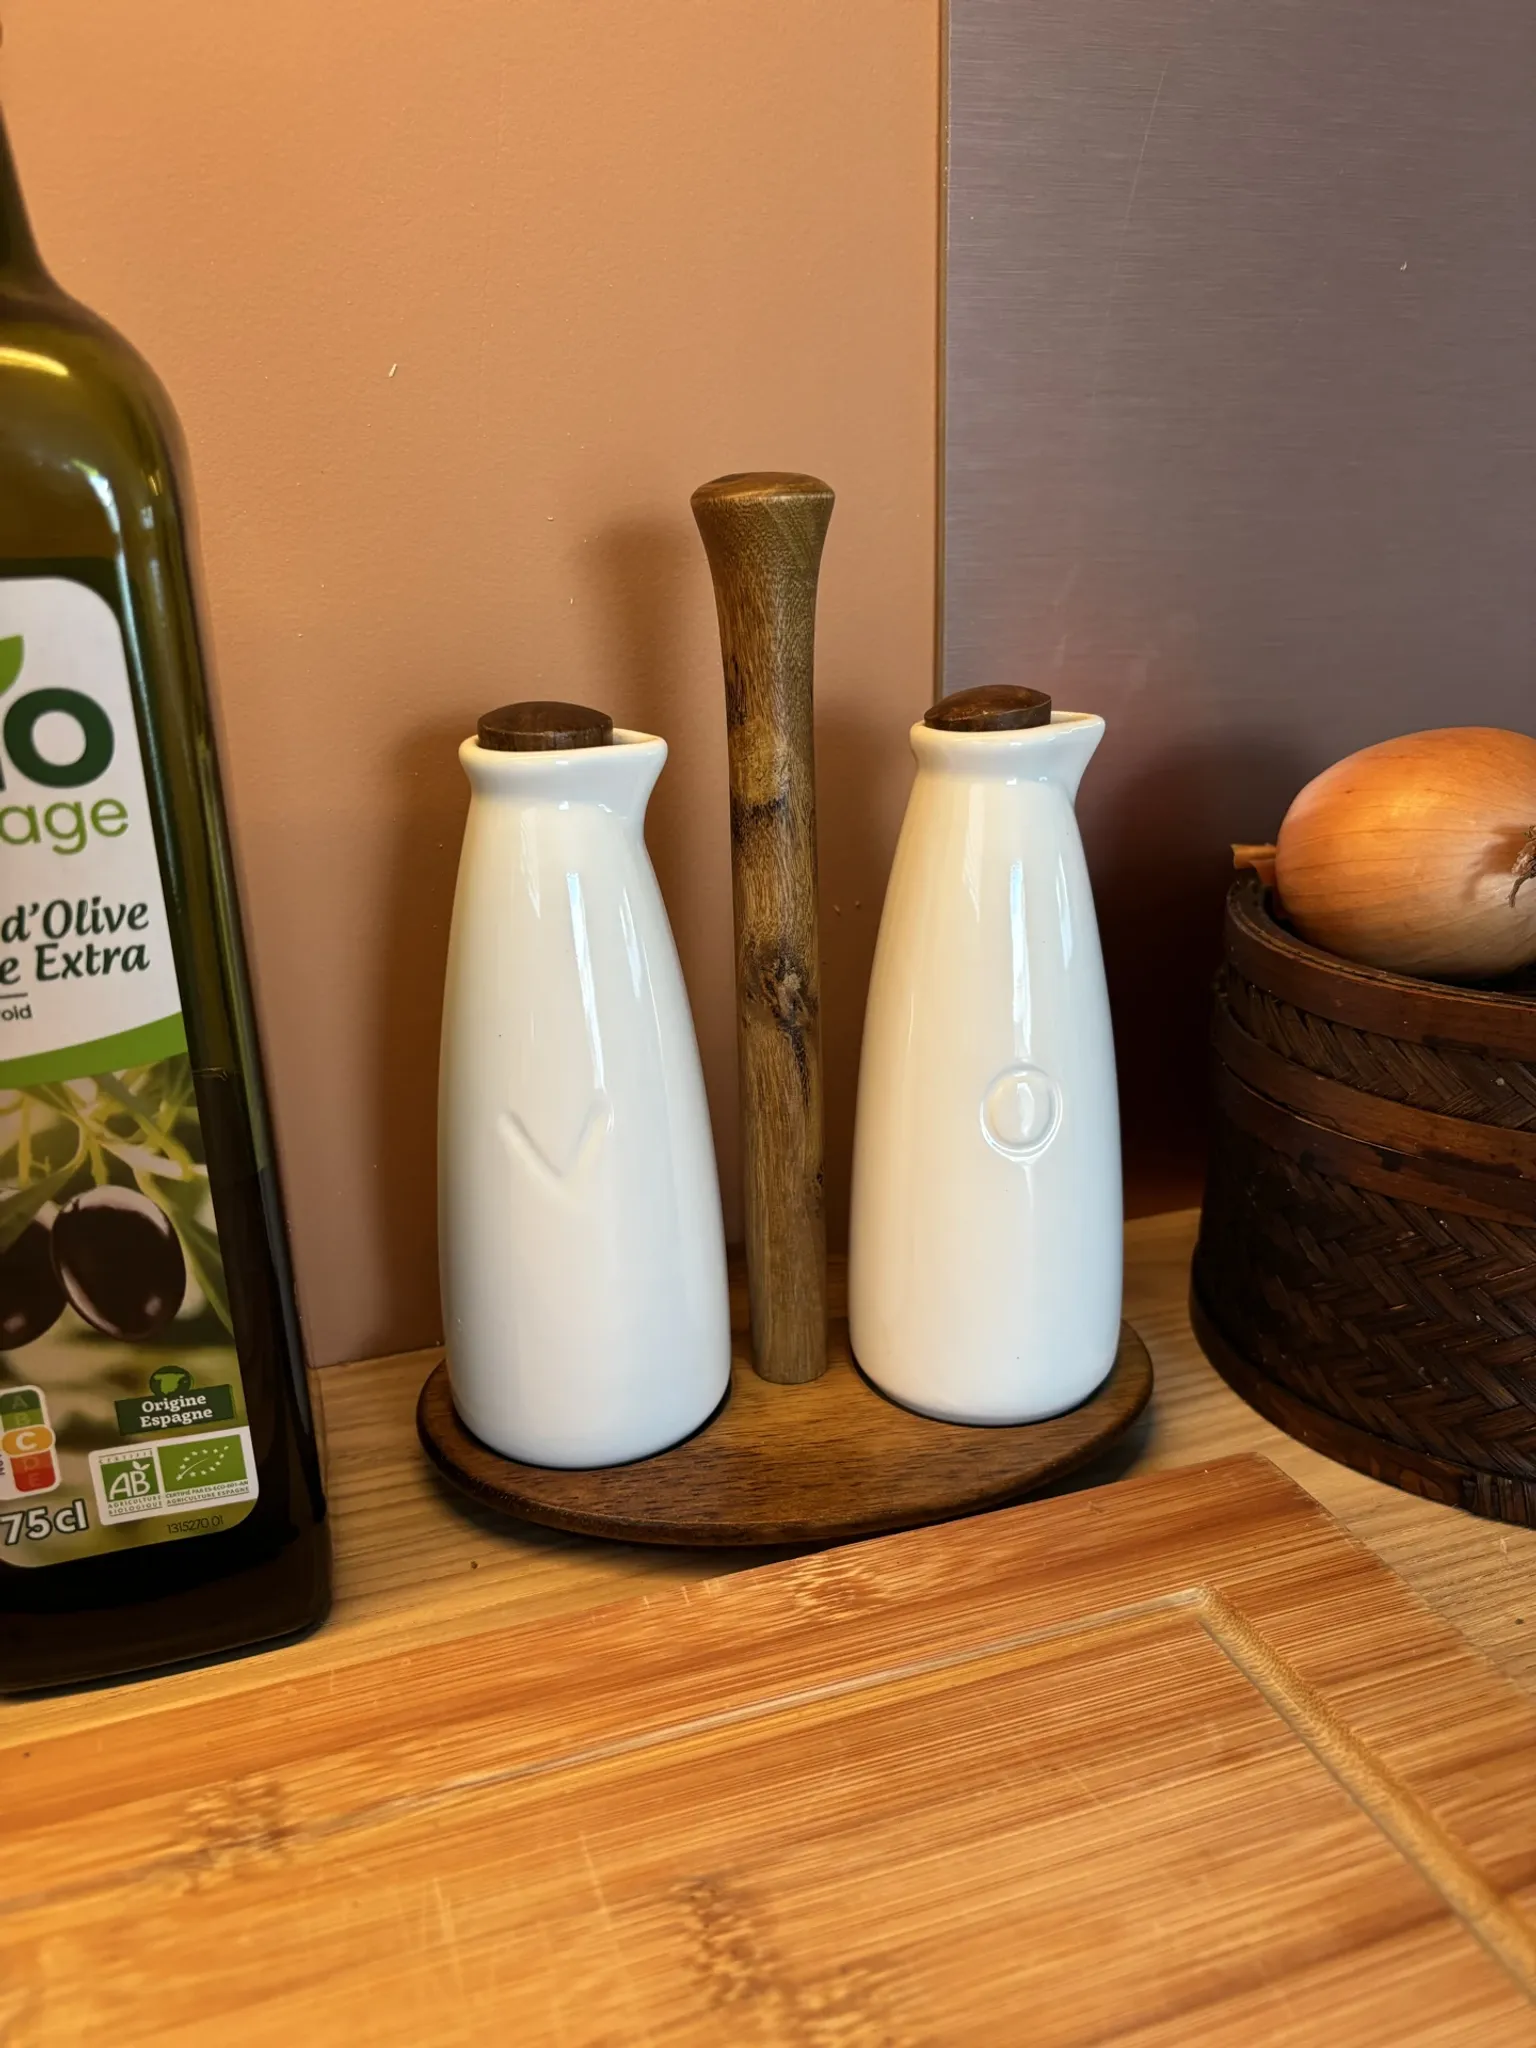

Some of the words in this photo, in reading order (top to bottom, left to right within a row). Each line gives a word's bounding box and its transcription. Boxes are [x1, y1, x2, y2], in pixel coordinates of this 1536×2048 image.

[34, 942, 151, 982] Extra
[142, 1395, 207, 1413] Origine
[139, 1408, 213, 1428] Espagne
[15, 1431, 37, 1451] C
[109, 1470, 151, 1501] AB
[167, 1493, 215, 1504] AGRICULTURE
[217, 1486, 249, 1497] ESPAGNE
[108, 1495, 161, 1509] AGRICULTURE
[109, 1501, 162, 1515] BIOLOGIQUE
[0, 1498, 89, 1546] 75cl
